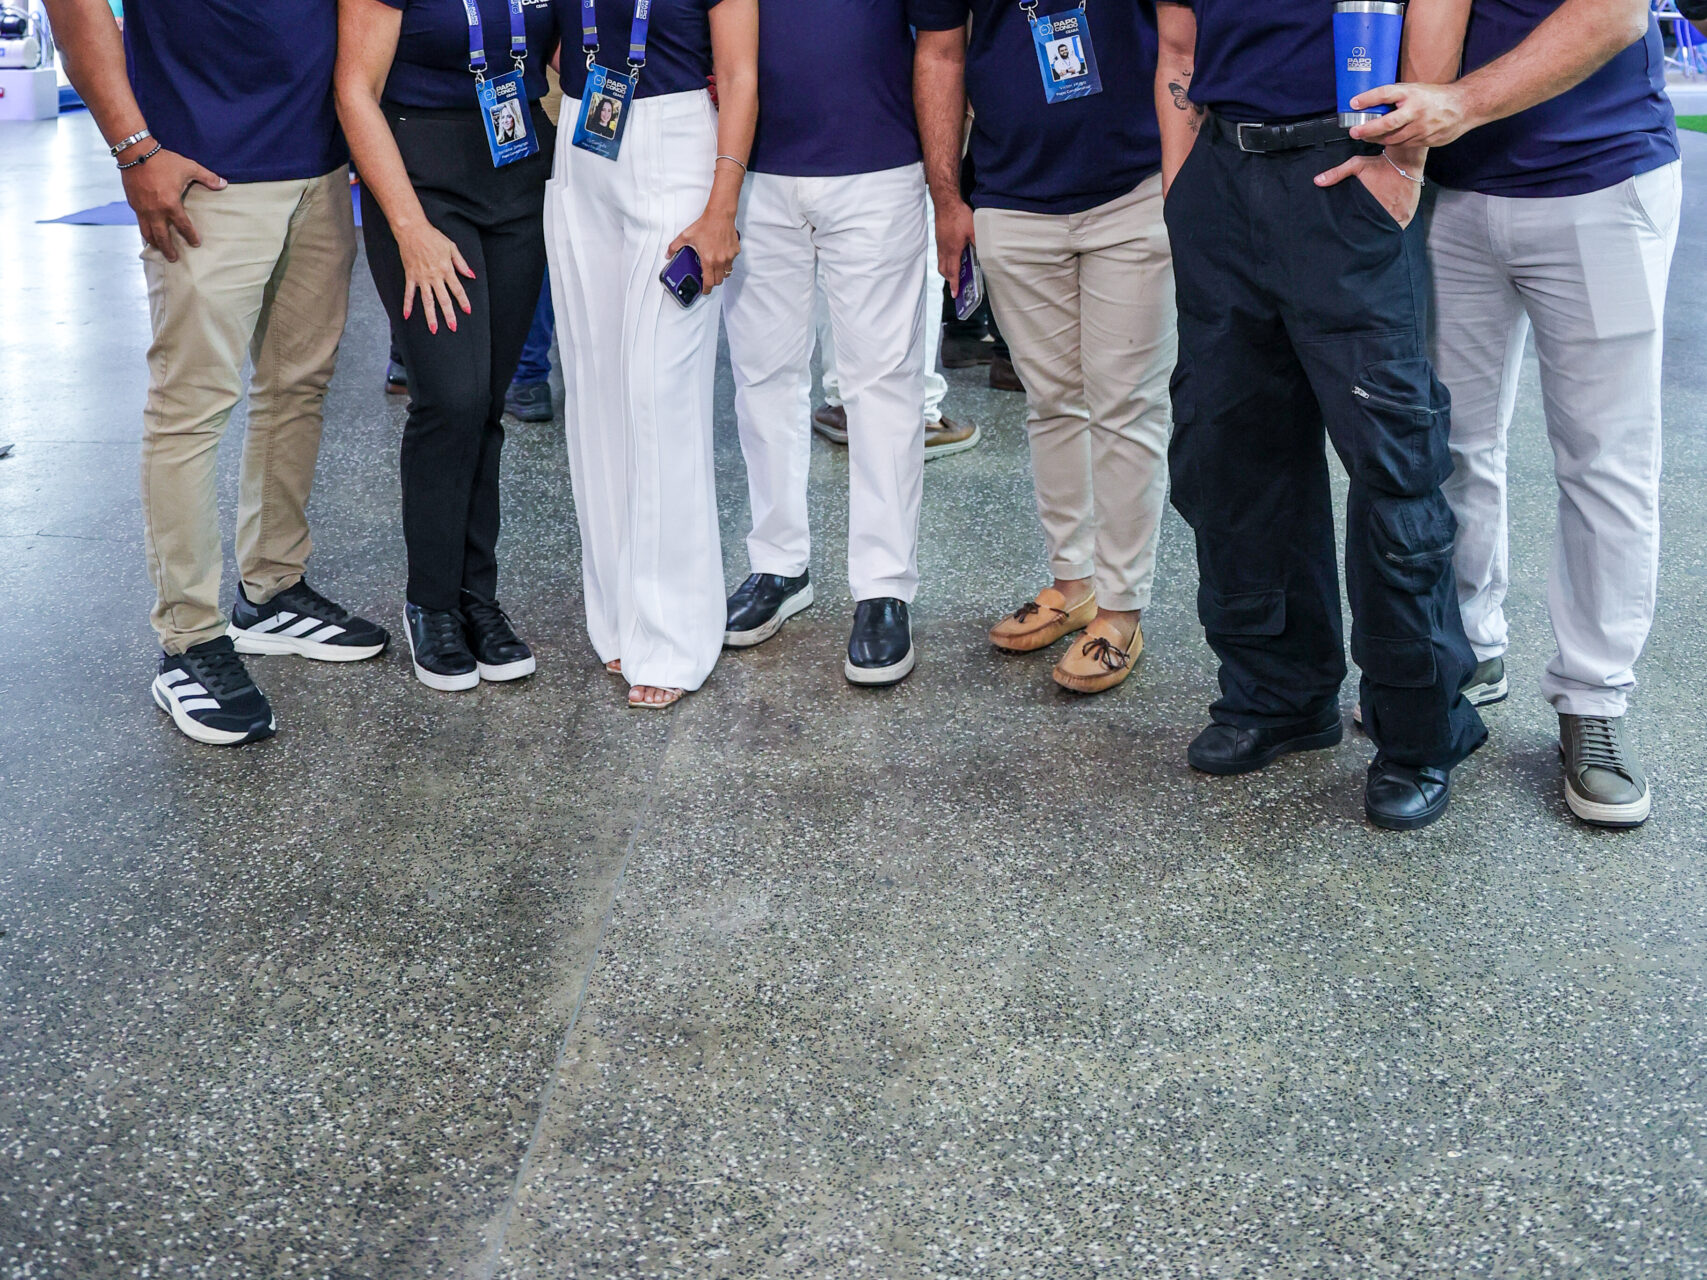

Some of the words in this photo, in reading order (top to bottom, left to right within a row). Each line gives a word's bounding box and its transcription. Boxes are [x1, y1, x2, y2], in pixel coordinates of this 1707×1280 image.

[1053, 18, 1077, 27] PAPO
[1054, 23, 1078, 32] CONDO
[496, 81, 516, 92] PAPO
[607, 79, 627, 90] PAPO
[497, 87, 516, 96] CONDO
